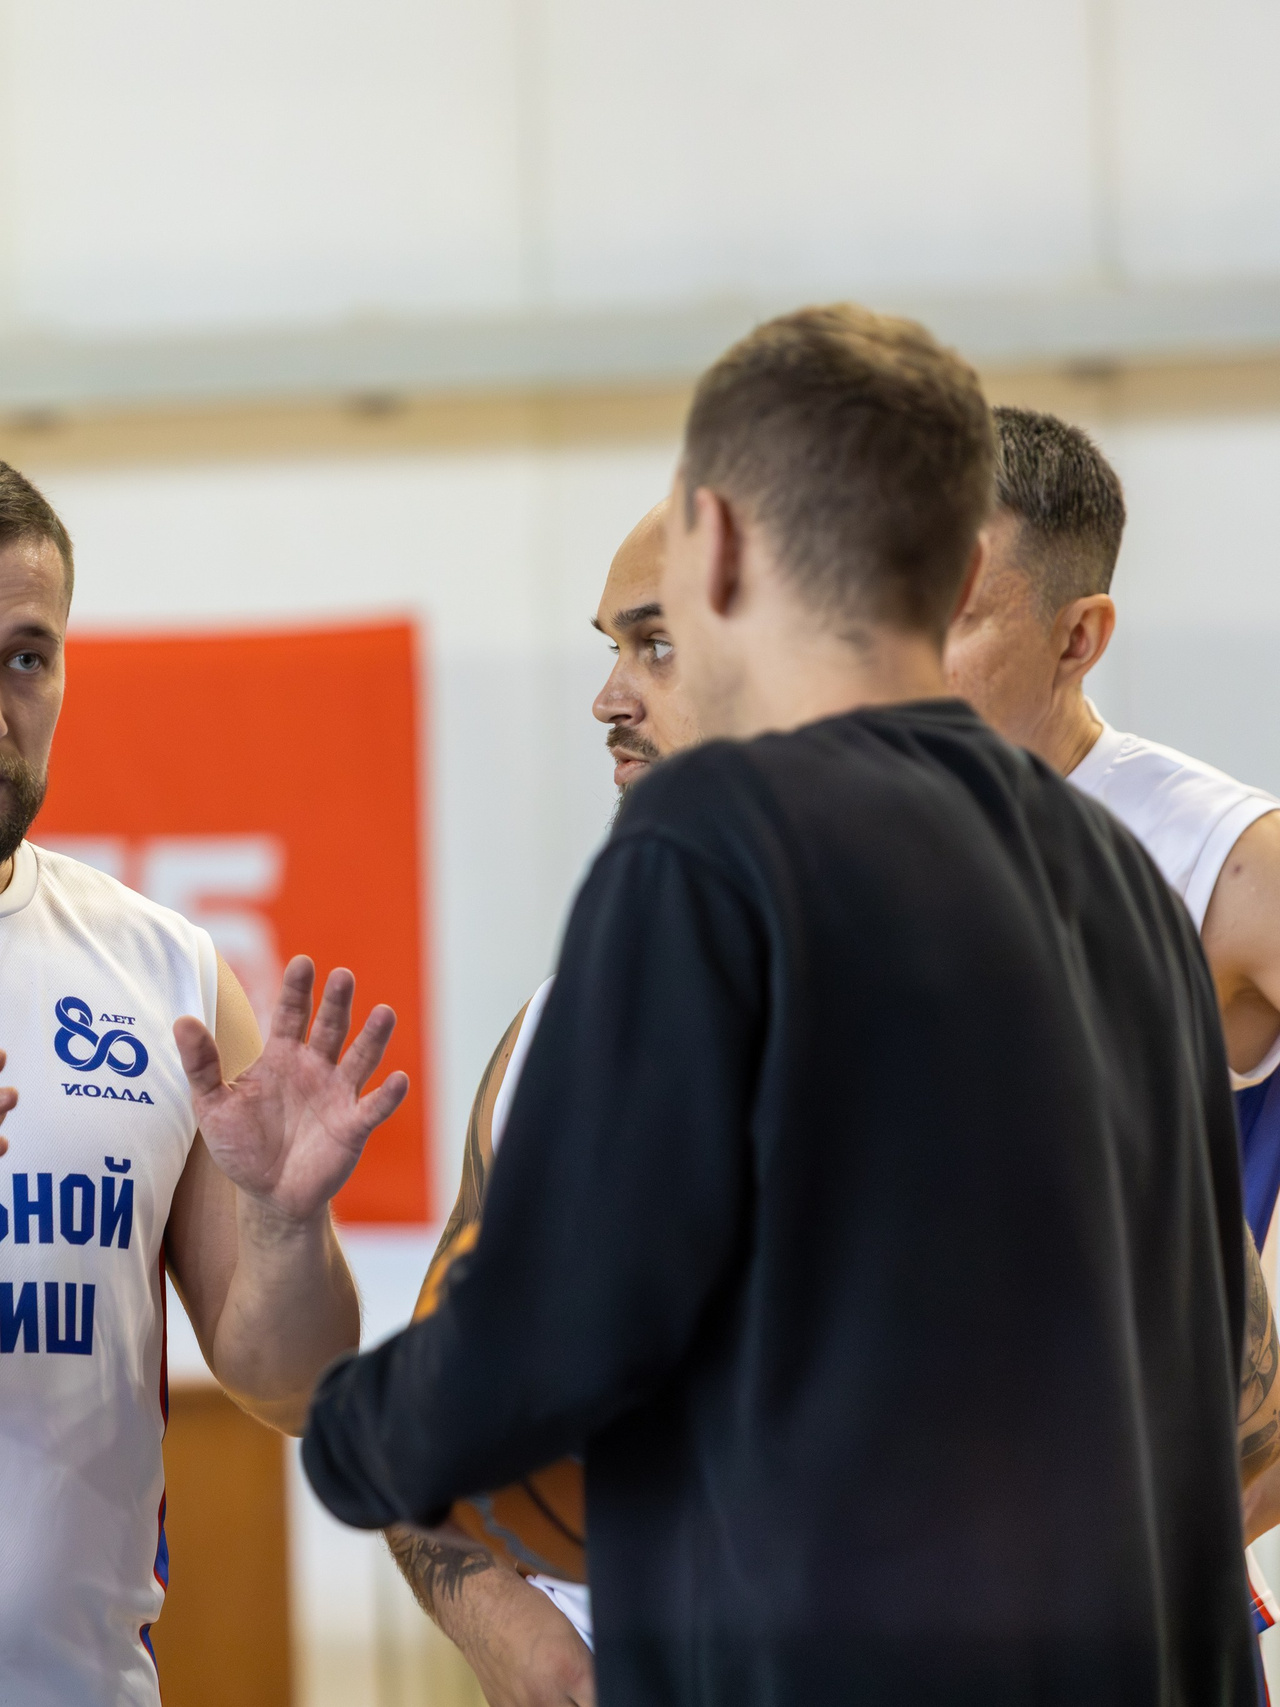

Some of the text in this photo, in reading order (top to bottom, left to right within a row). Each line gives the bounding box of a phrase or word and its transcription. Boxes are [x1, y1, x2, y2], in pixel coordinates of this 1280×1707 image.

[99, 1013, 135, 1025] ЛЕТ
[54, 996, 149, 1078] 80
[61, 1083, 155, 1105] ИОЛЛА
